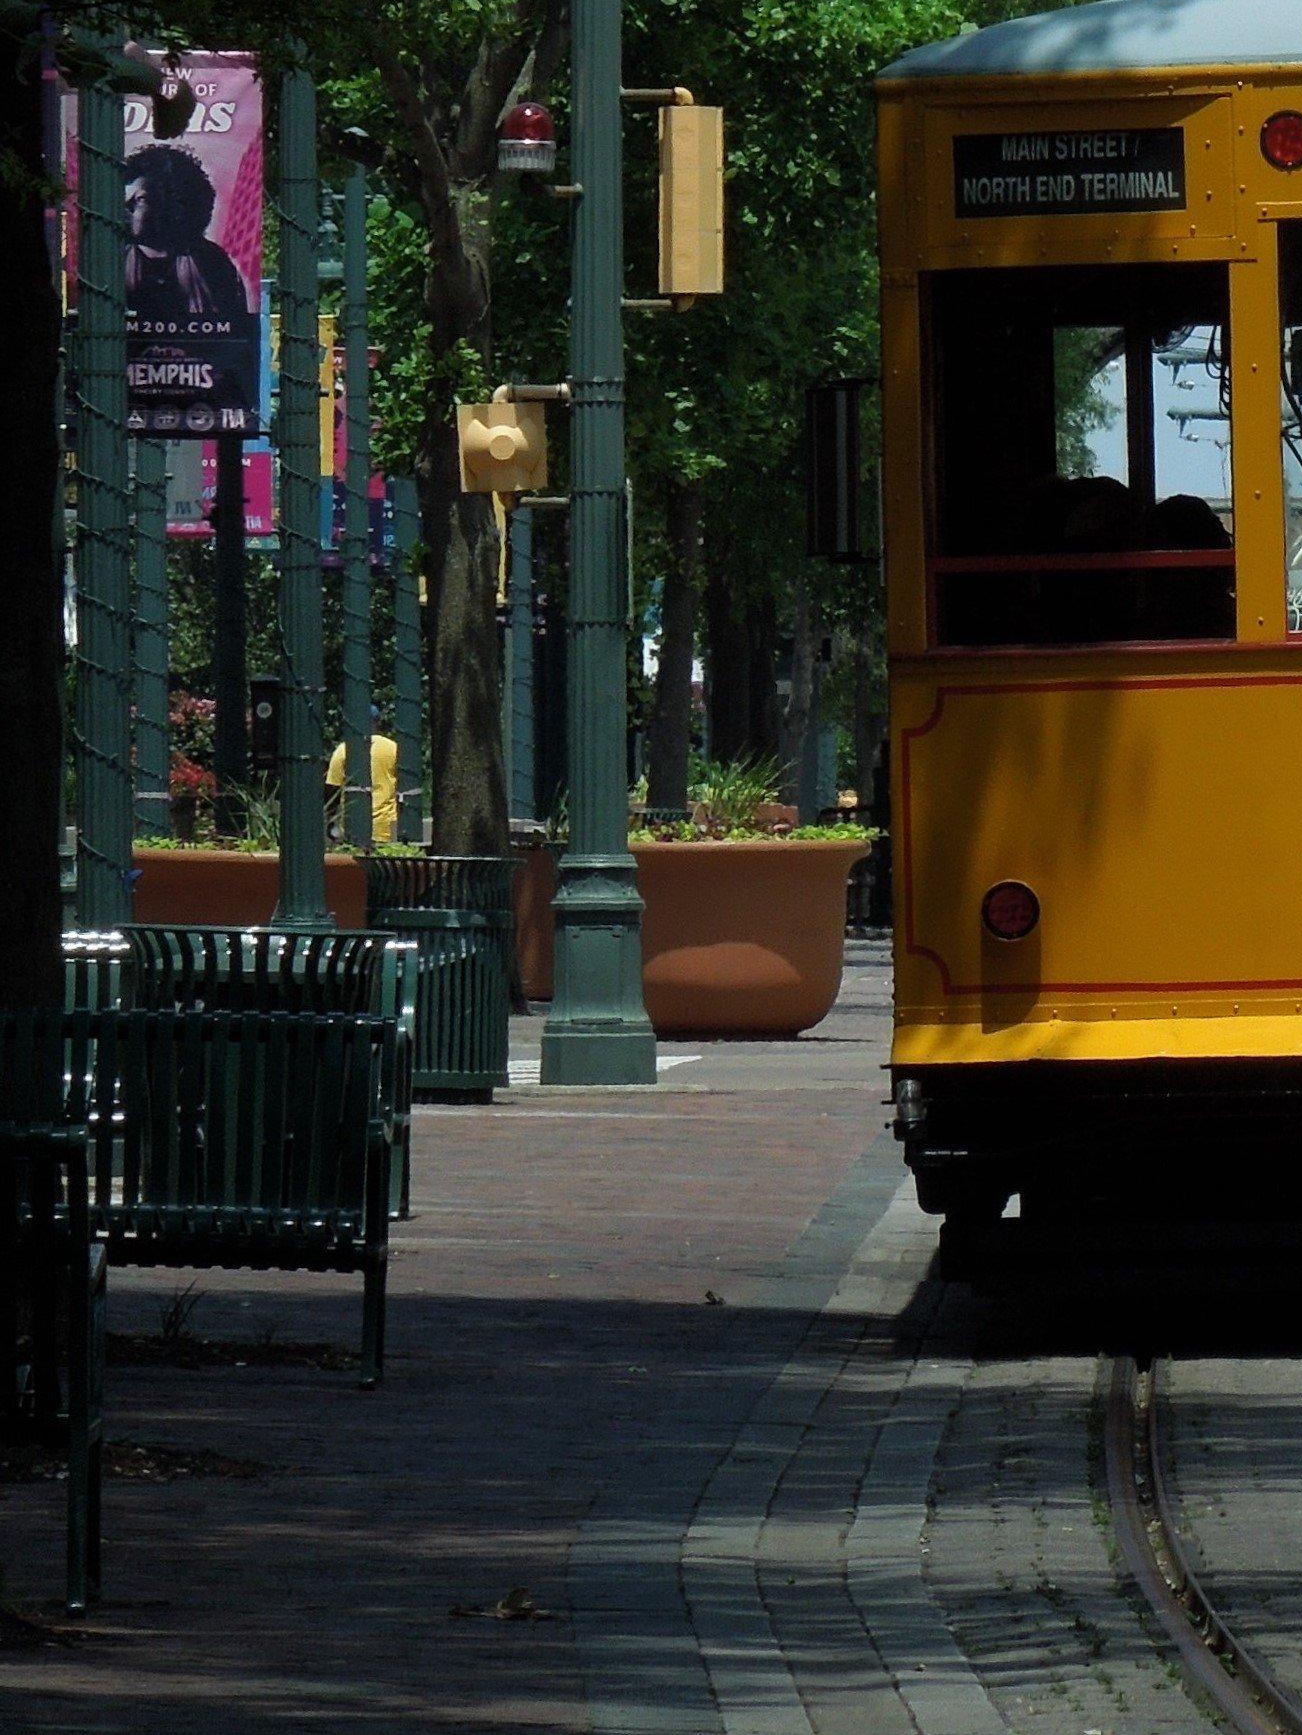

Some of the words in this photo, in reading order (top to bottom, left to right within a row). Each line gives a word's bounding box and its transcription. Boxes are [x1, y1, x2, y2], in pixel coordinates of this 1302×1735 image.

[195, 83, 218, 96] OF
[1001, 138, 1050, 161] MAIN
[1055, 133, 1128, 160] STREET
[962, 175, 1030, 204] NORTH
[1036, 175, 1075, 202] END
[1081, 171, 1180, 201] TERMINAL
[126, 321, 231, 333] M200.COM
